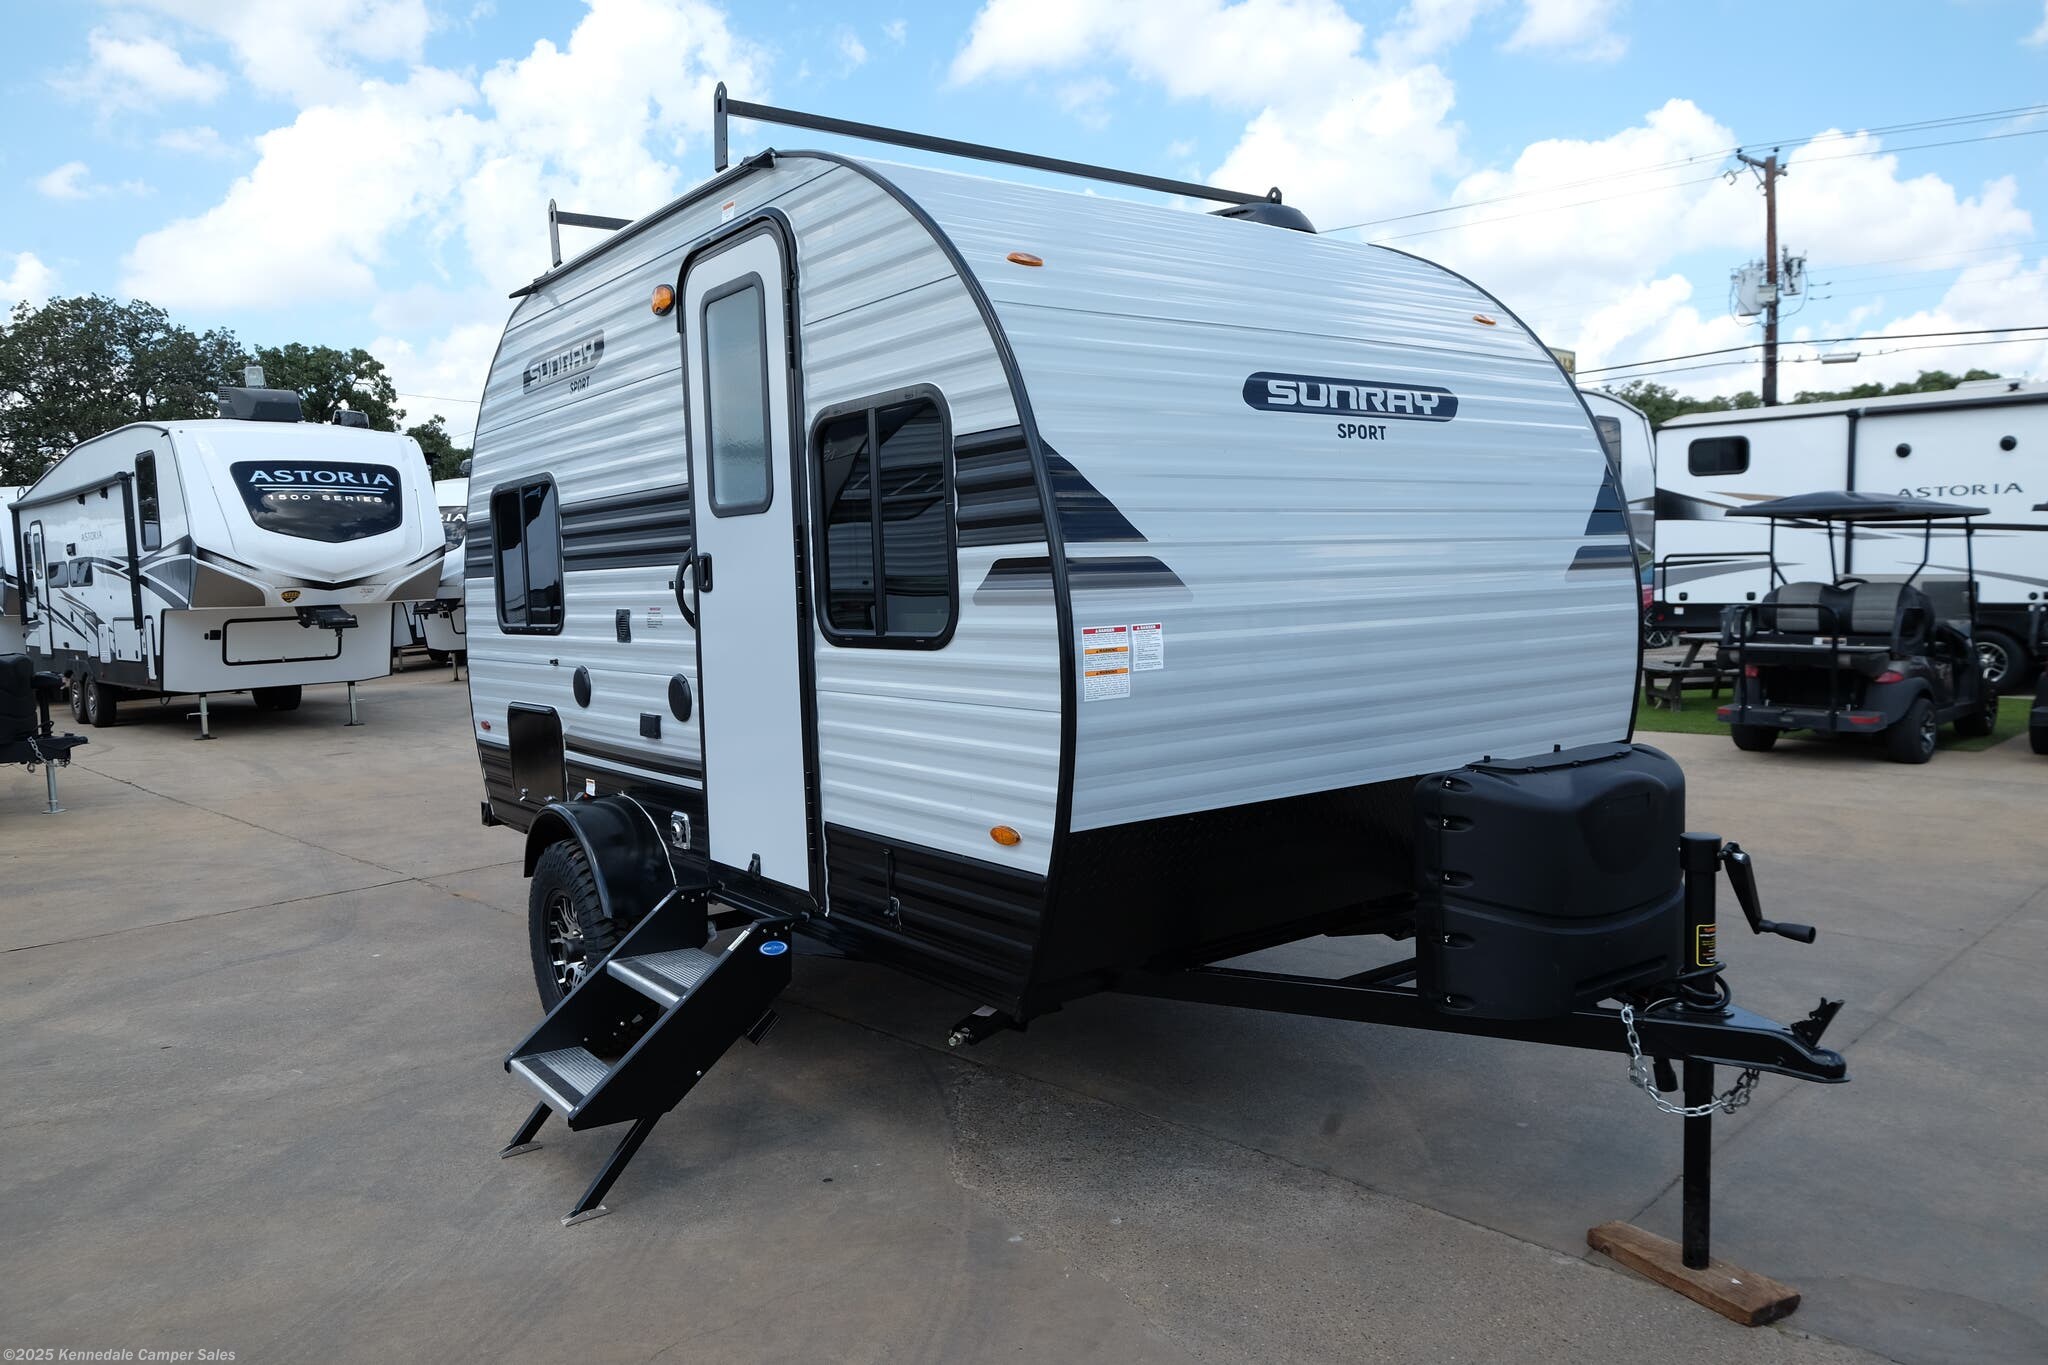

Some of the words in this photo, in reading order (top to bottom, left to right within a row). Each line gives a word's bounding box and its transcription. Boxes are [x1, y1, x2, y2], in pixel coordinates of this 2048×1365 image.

[1267, 379, 1439, 415] SUNRAY
[1337, 423, 1387, 441] SPORT
[249, 469, 395, 487] ASTORIA
[321, 494, 383, 503] SERIES
[1898, 482, 2023, 499] ASTORIA
